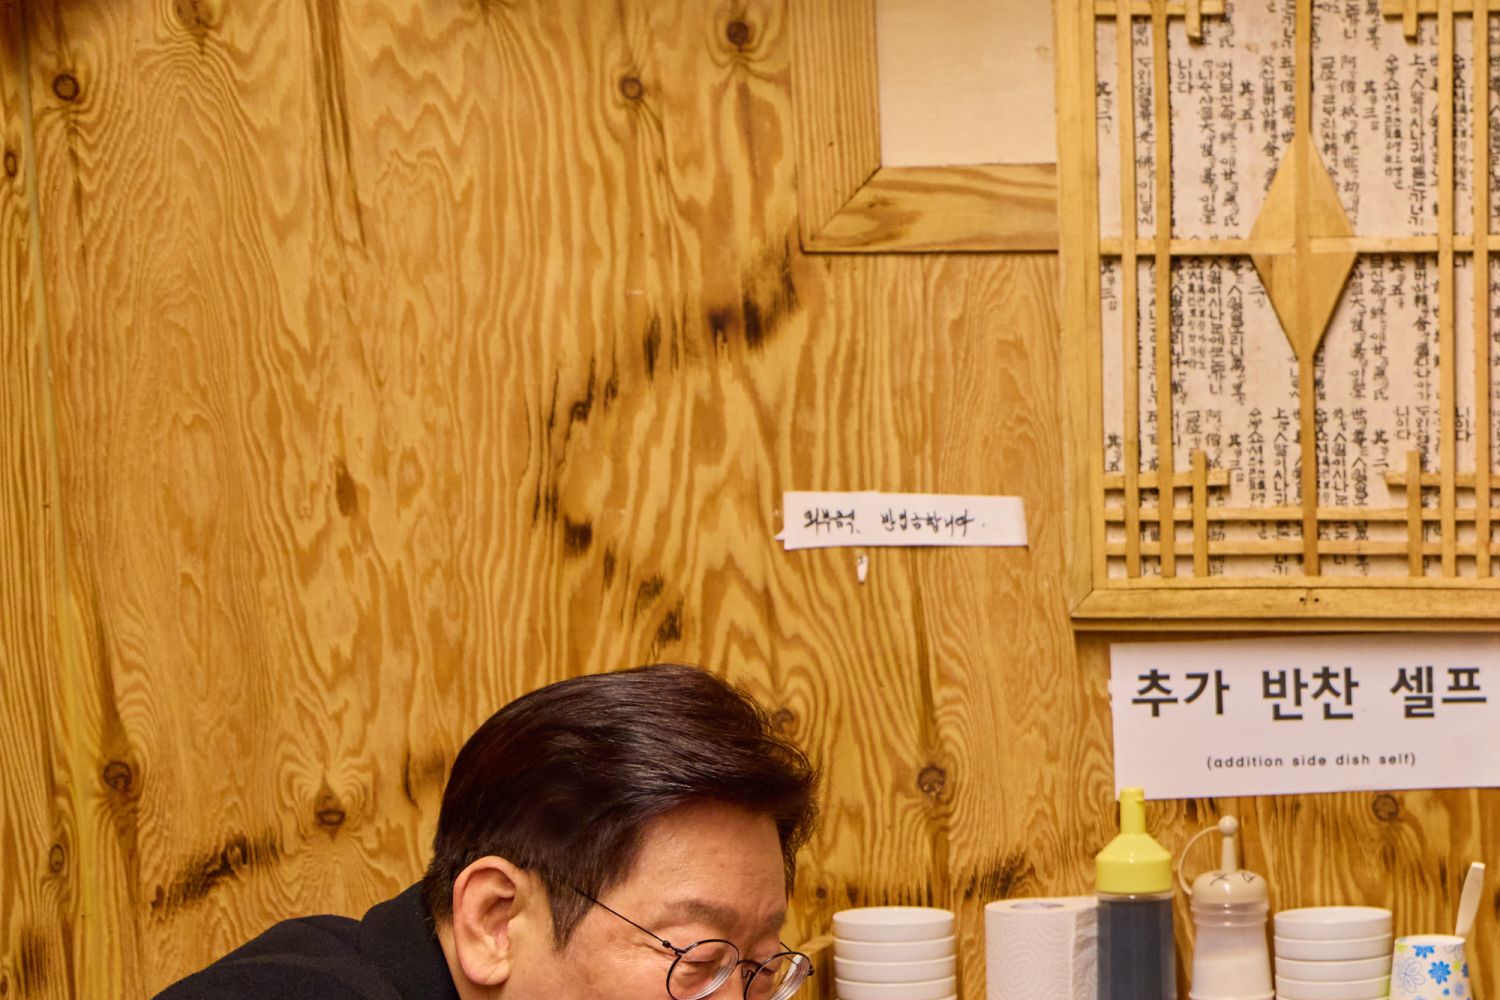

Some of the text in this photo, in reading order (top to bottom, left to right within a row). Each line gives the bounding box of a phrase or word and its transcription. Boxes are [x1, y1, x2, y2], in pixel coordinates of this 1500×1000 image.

[1131, 665, 1488, 722] 추가 반찬 셀프
[1206, 751, 1417, 770] (addition side dish self)
